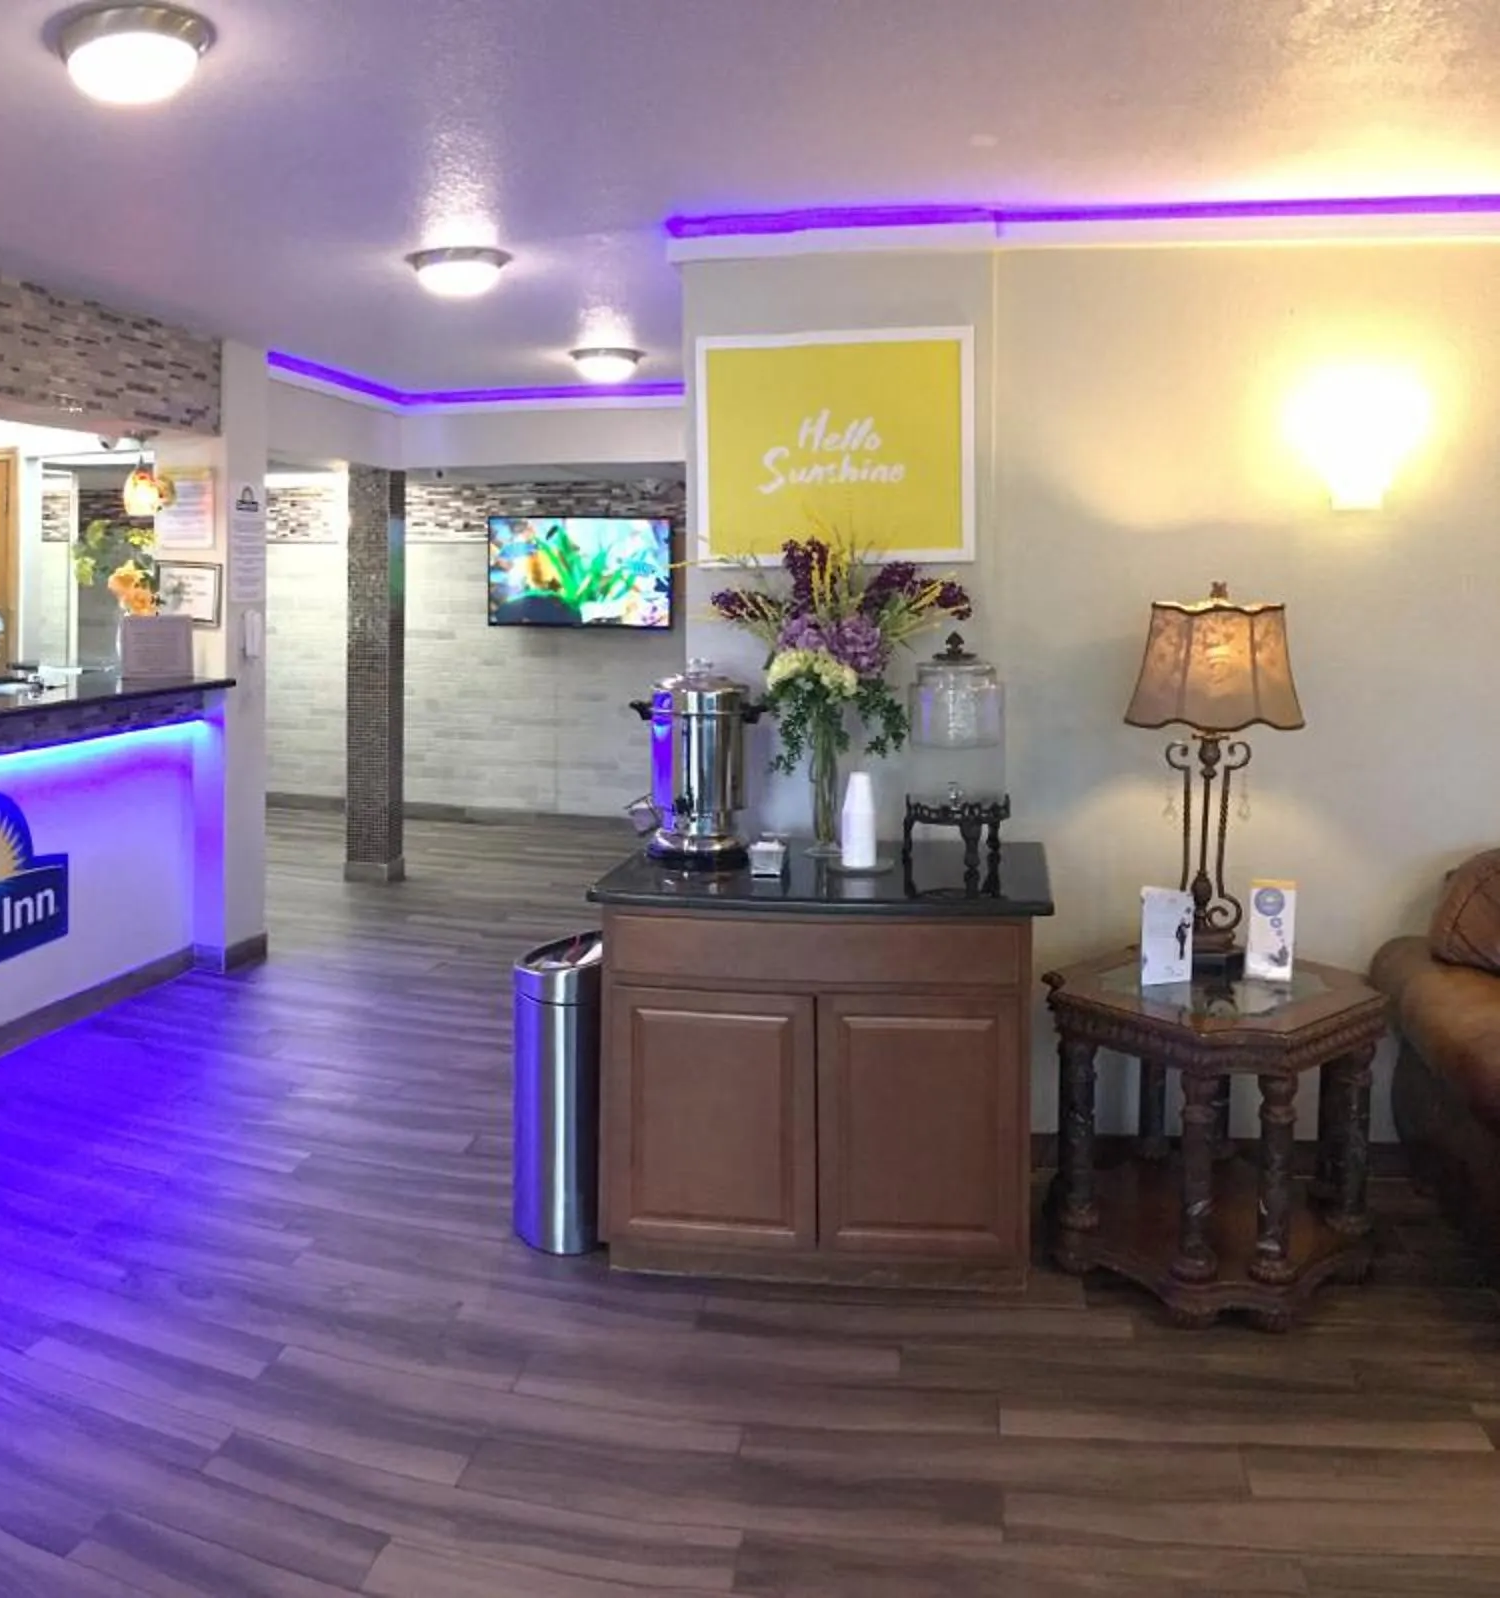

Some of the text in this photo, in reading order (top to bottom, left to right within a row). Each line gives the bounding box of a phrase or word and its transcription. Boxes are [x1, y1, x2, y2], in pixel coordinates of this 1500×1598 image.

[798, 408, 881, 452] Hello
[757, 446, 905, 494] Sunshine
[2, 888, 56, 934] Inn
